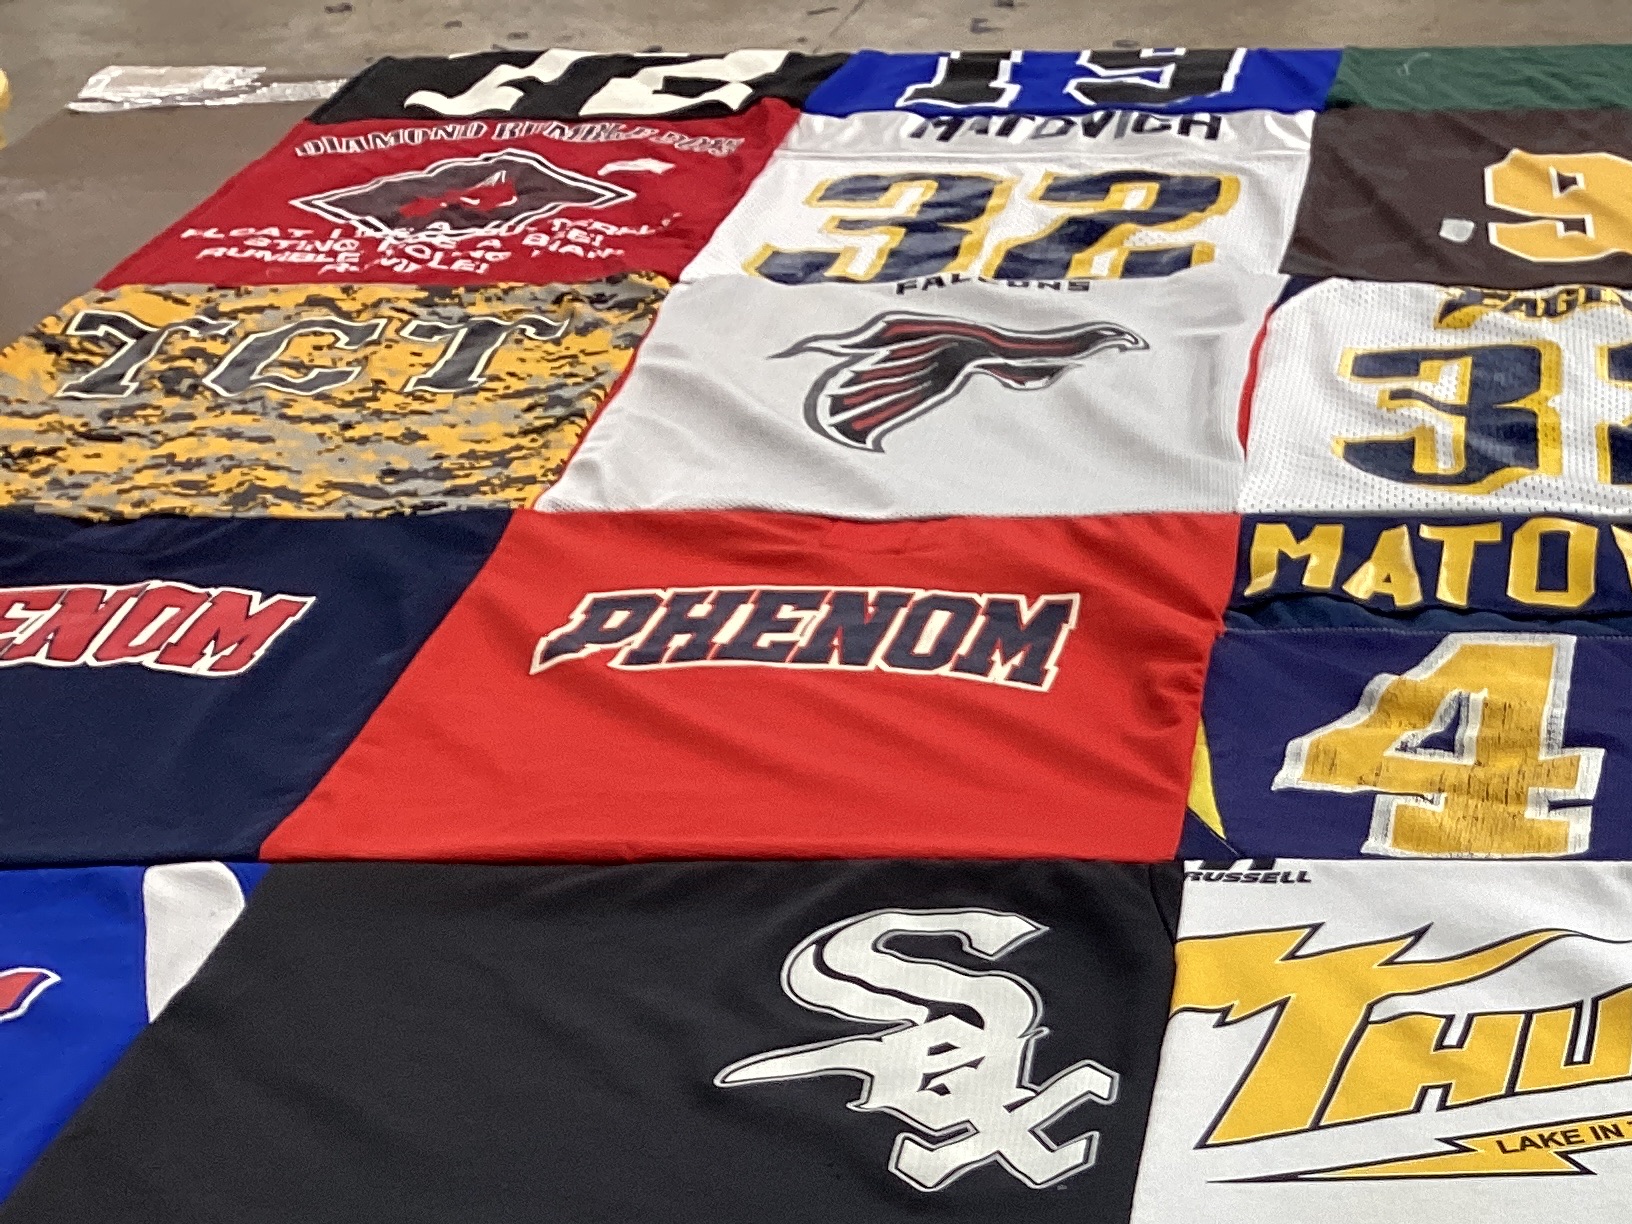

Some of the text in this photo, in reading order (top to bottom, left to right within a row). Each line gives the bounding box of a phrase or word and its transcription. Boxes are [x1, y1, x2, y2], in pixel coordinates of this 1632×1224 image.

[742, 169, 1241, 286] 32
[55, 309, 571, 398] TCT
[530, 584, 1081, 692] PHENOM
[1183, 870, 1313, 884] RUSSELL
[1495, 1131, 1585, 1155] LAKE
[1594, 1123, 1624, 1141] IN
